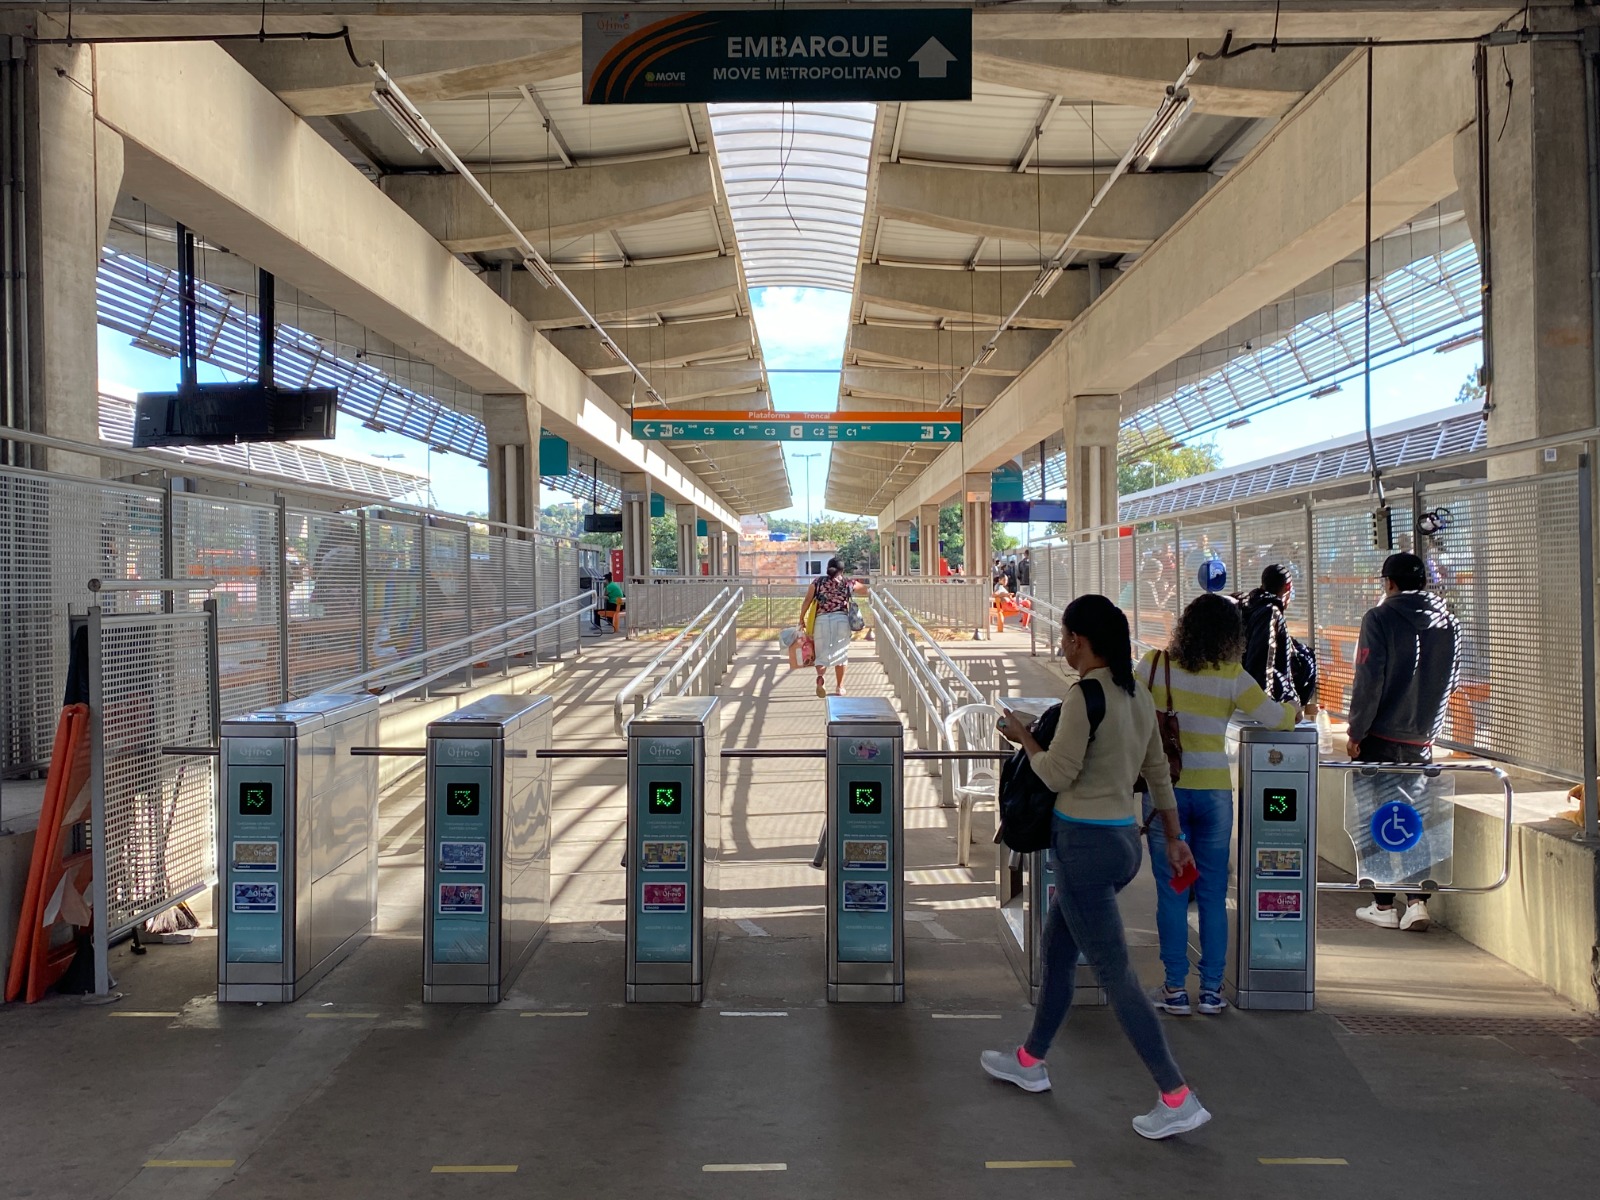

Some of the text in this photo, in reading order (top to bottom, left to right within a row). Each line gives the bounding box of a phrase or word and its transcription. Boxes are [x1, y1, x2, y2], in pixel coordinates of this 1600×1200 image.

[727, 35, 889, 58] EMBARQUE
[656, 72, 686, 81] MOVE
[713, 66, 902, 80] MOVE METROPOLITANO
[748, 411, 791, 419] Plataforma
[673, 427, 685, 435] C6
[703, 427, 715, 435] C5
[733, 427, 745, 435] C4
[764, 428, 776, 436] C3
[793, 428, 800, 436] C
[813, 428, 825, 436] C2
[846, 428, 857, 436] C1
